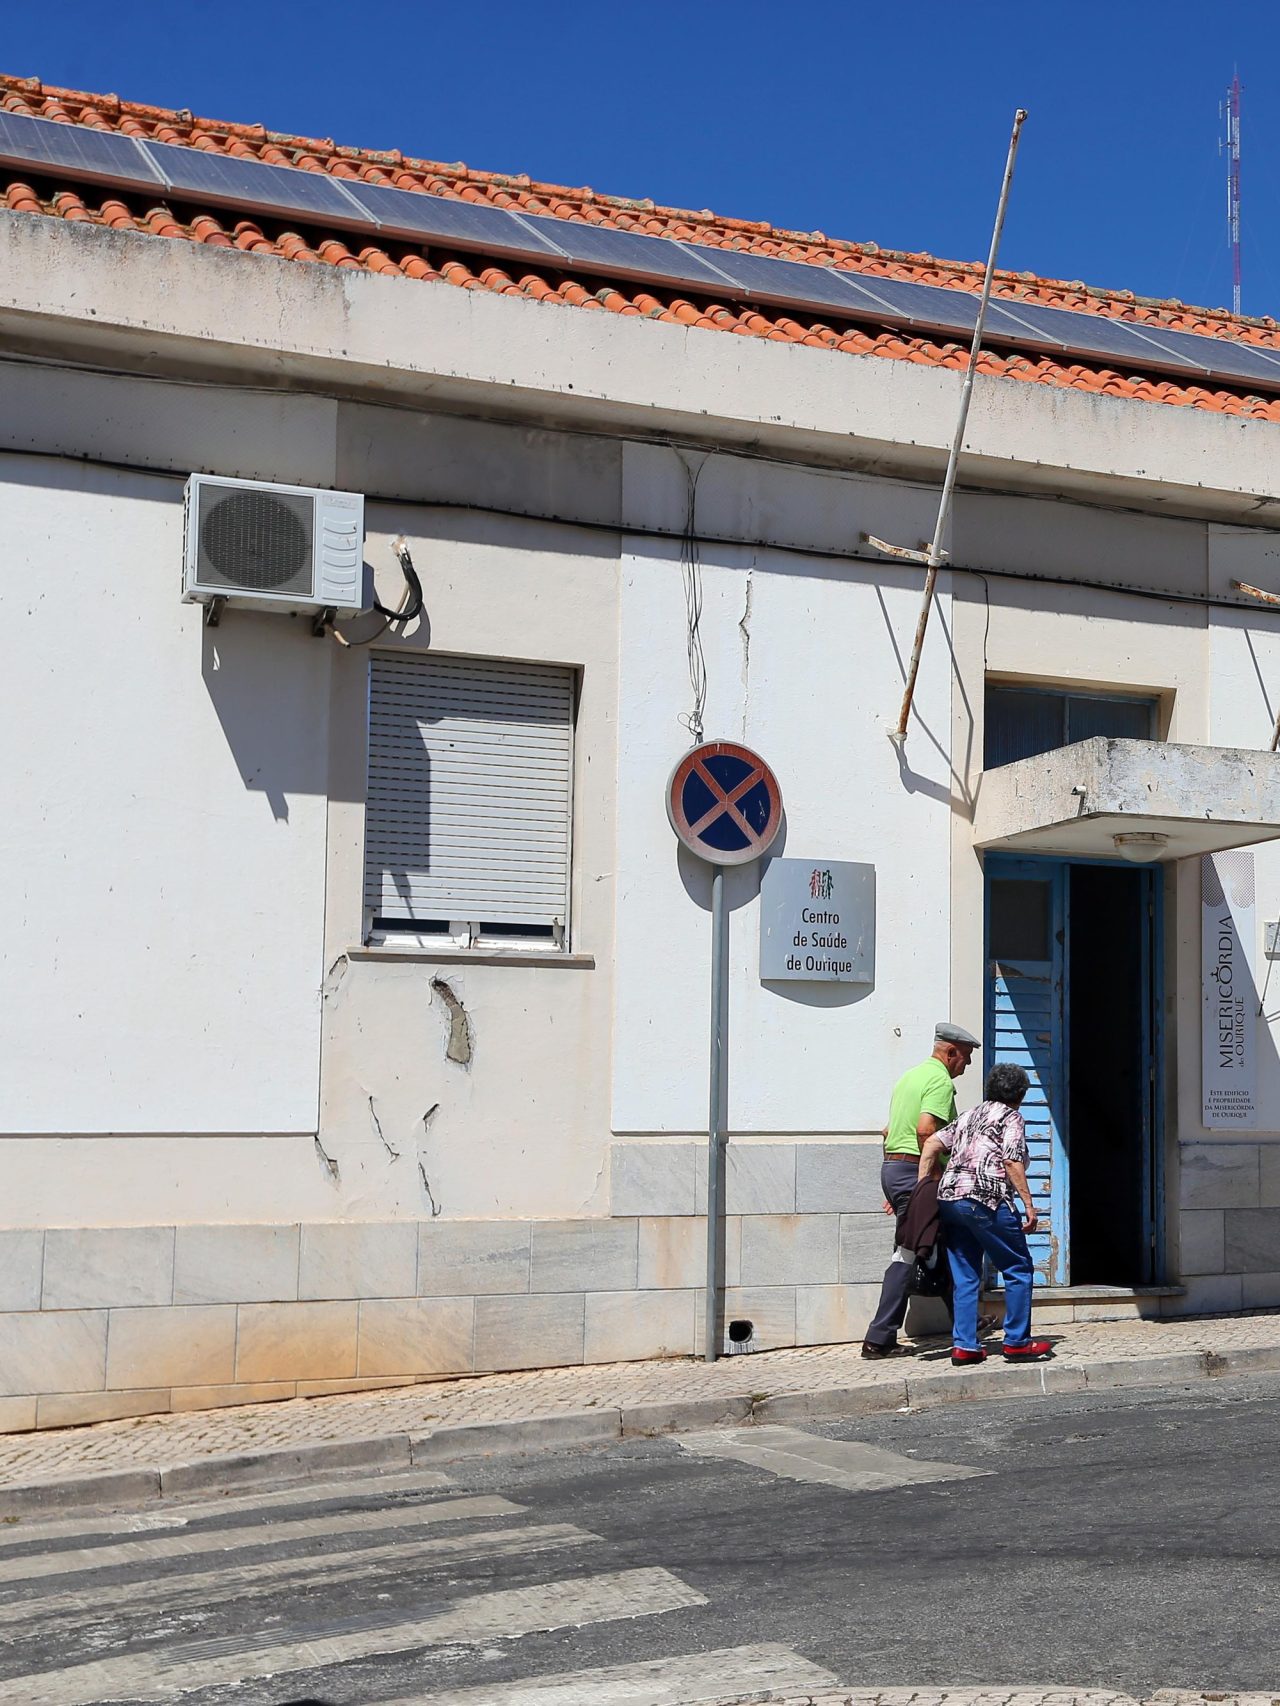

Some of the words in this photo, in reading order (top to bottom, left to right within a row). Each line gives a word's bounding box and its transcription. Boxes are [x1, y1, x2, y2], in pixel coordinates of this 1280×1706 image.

[801, 908, 840, 925] Centro
[793, 931, 808, 947] de
[812, 932, 848, 949] Saúde
[786, 955, 802, 971] de
[805, 956, 852, 976] Ourique
[1234, 996, 1246, 1056] OURIQUE
